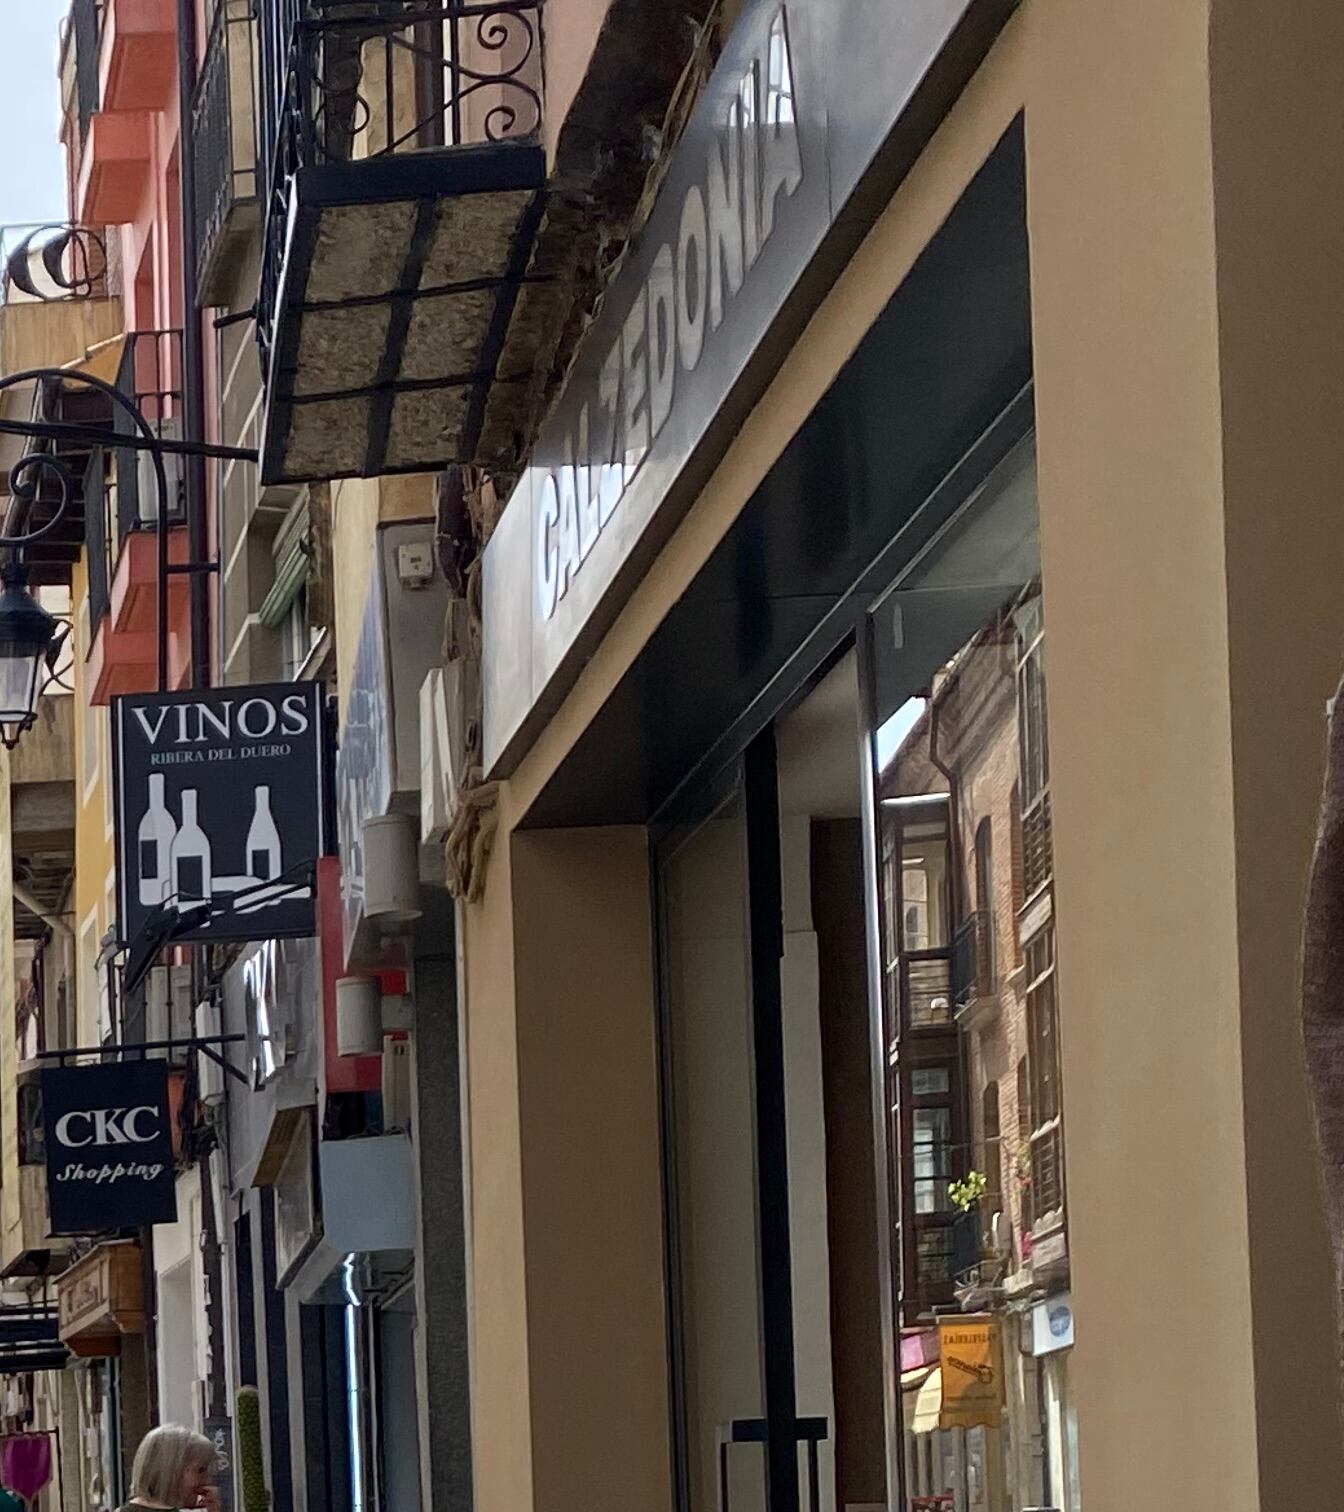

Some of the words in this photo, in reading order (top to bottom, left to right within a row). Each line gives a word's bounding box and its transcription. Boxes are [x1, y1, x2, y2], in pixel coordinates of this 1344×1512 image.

[131, 695, 310, 746] VINOS
[150, 751, 205, 766] RIBERA
[207, 747, 236, 762] DEL
[239, 743, 292, 759] DUERO
[55, 1105, 161, 1148] CKC
[56, 1160, 165, 1184] Shopping
